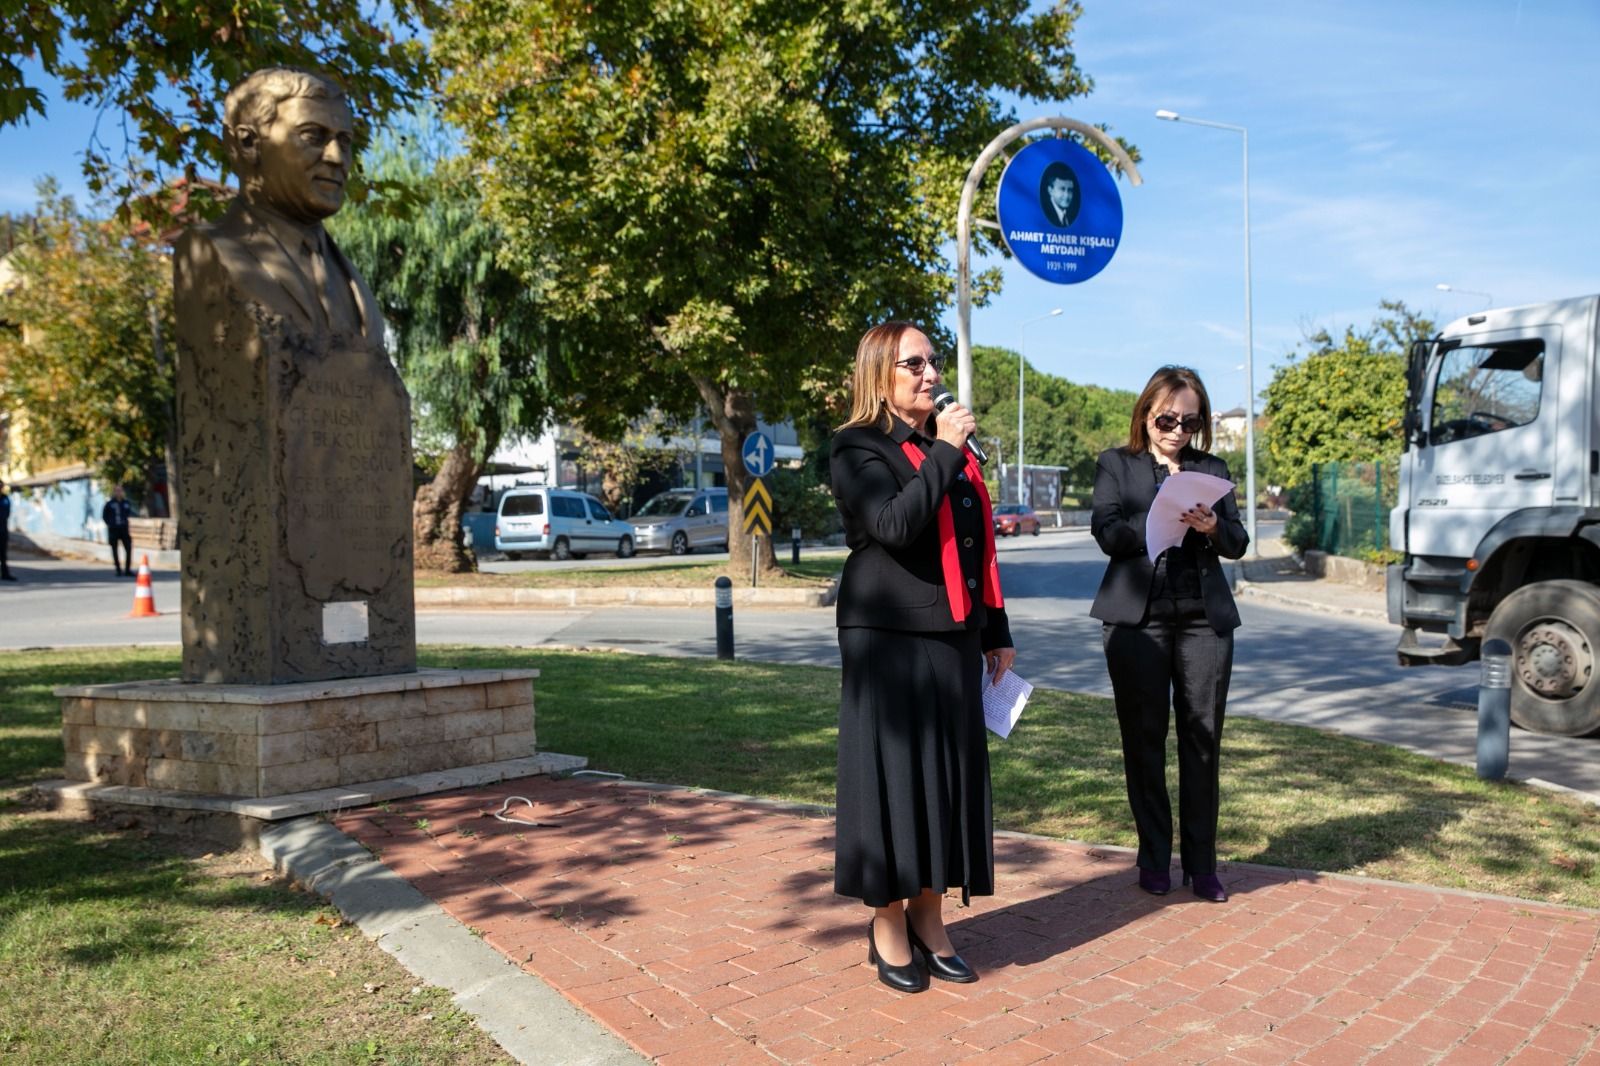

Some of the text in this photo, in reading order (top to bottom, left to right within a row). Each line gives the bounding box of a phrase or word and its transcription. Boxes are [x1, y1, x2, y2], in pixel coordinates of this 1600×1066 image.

[1010, 230, 1115, 248] AHMET TANER KIŞLALI
[1041, 244, 1085, 256] MEYDANI
